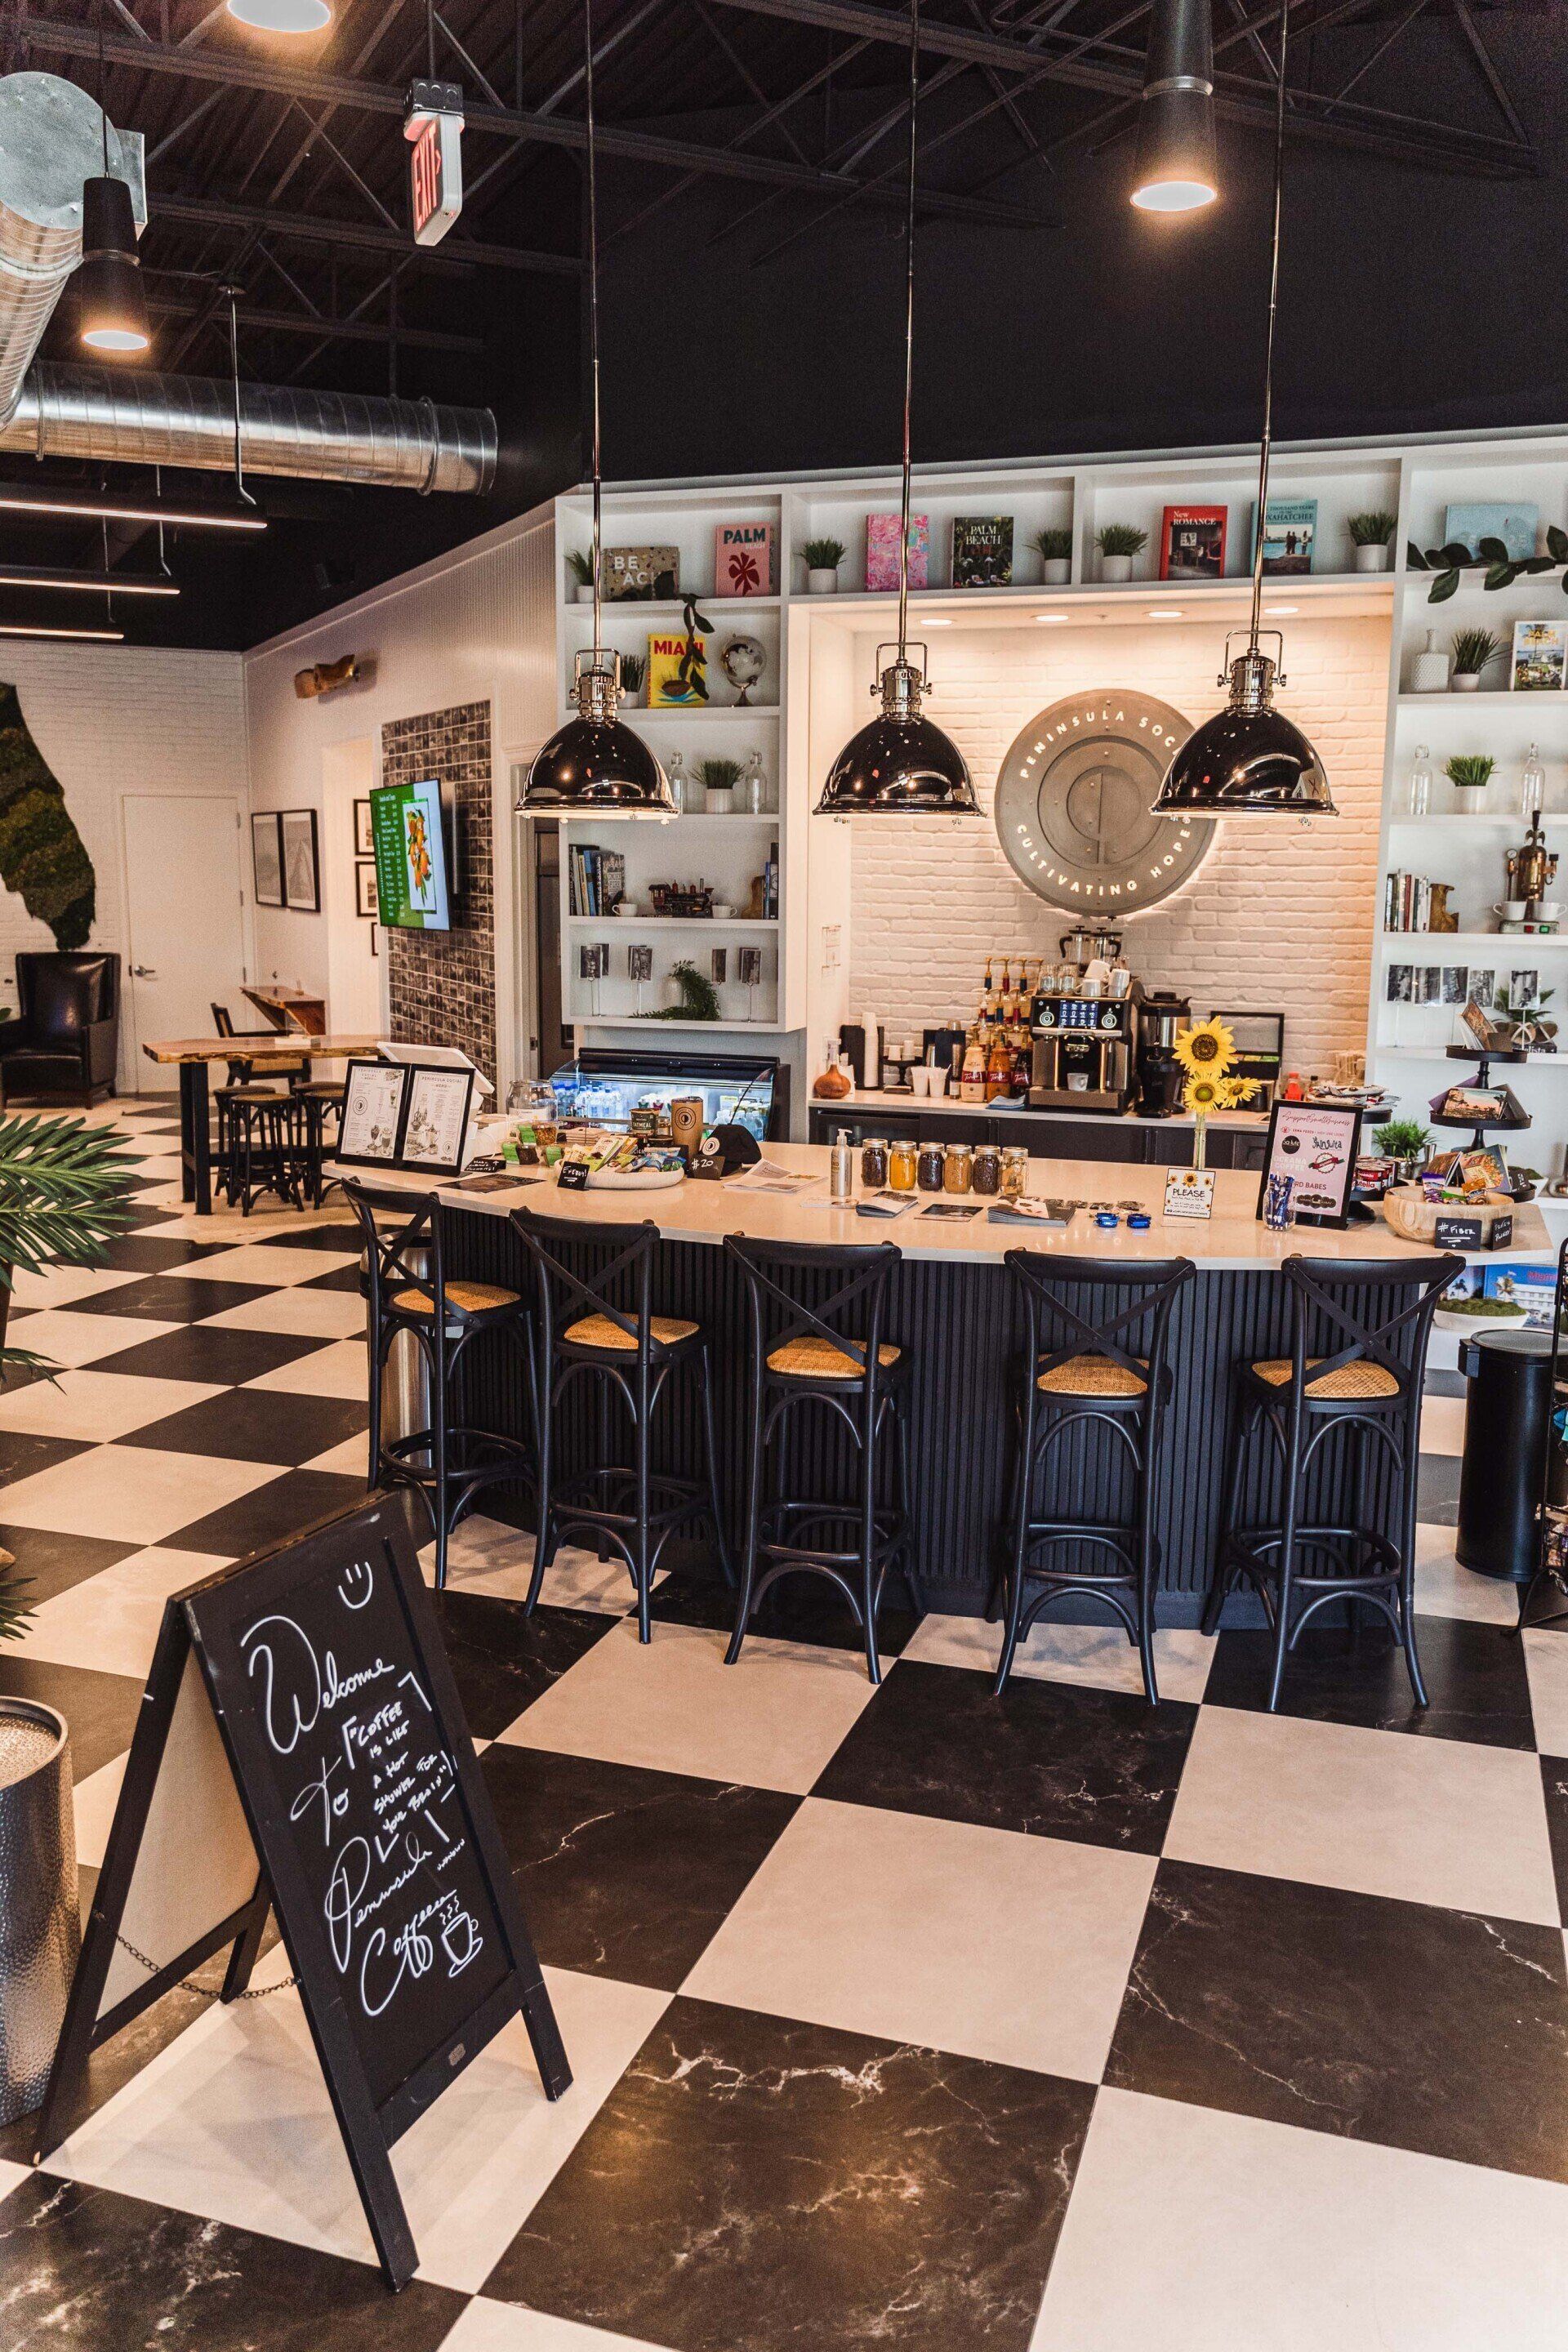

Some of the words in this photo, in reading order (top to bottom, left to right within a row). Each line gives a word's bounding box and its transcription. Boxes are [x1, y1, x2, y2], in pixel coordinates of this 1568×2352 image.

[1173, 518, 1216, 526] ROMANCE
[1265, 513, 1314, 521] XAHATCHEE
[723, 528, 766, 544] PALM
[969, 525, 996, 535] PALM
[965, 534, 1000, 545] BEACH
[614, 556, 639, 570] BE
[623, 572, 656, 586] AC
[1020, 710, 1125, 778] PENINSULA
[1138, 715, 1182, 755] SOC
[1018, 825, 1137, 896] CULTIVATING
[1173, 1187, 1205, 1198] PLEASE
[1305, 1182, 1327, 1190] BABES
[1450, 1225, 1476, 1235] FIBER
[240, 1615, 395, 1754] Welcome
[369, 1744, 382, 1759] IS
[385, 1719, 410, 1746] LIKE
[373, 1774, 382, 1789] A
[385, 1751, 409, 1778] HOT
[373, 1776, 416, 1815] SHOWER
[416, 1753, 438, 1772] FOR
[381, 1810, 408, 1834] YOUR
[324, 1831, 433, 1974] Peninsula
